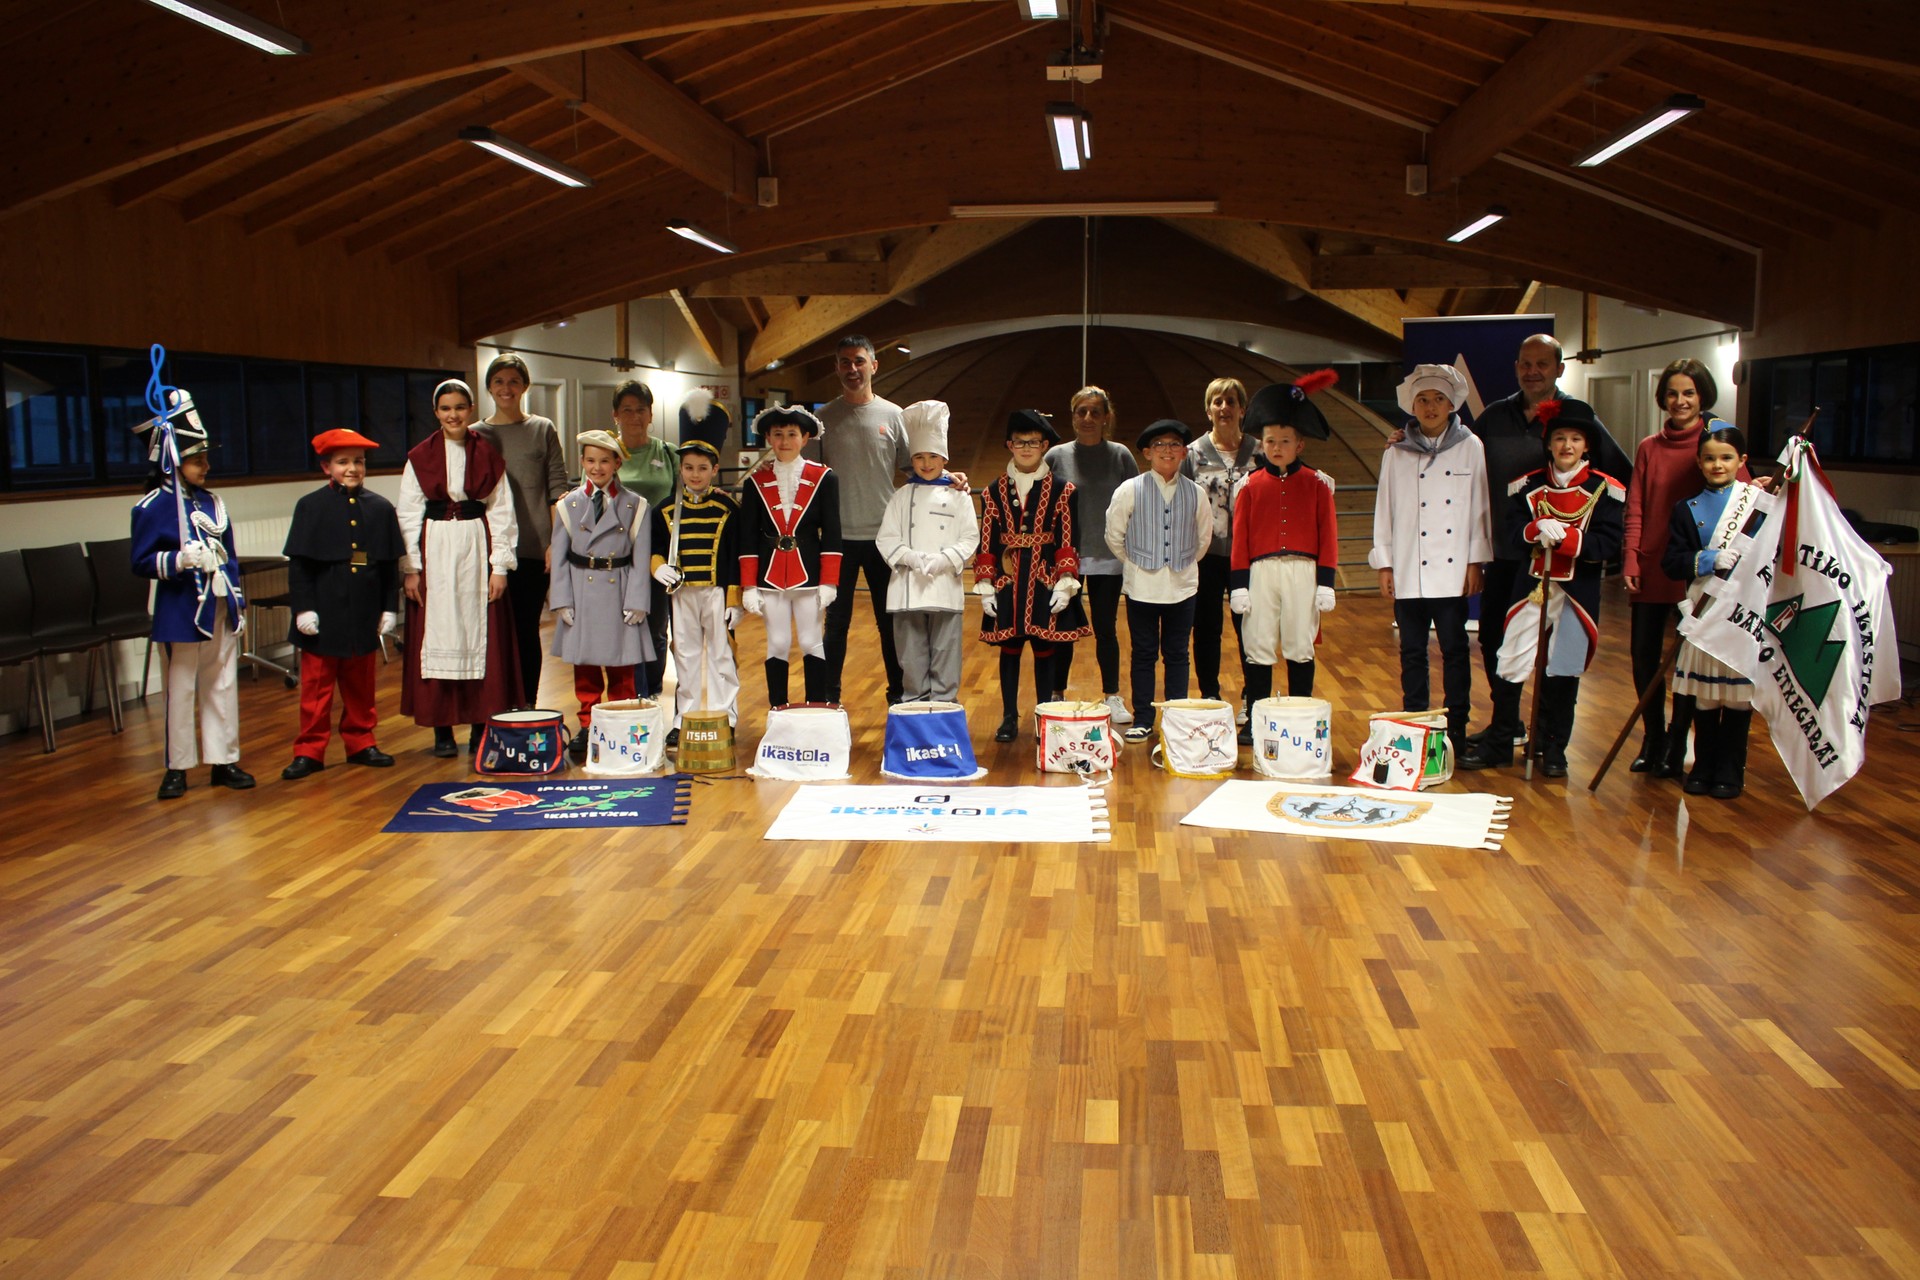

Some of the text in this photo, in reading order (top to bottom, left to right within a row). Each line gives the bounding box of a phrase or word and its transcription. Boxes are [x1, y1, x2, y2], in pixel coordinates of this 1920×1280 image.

[1717, 485, 1751, 550] KASTOLA
[686, 731, 717, 741] ITSASI
[762, 745, 830, 762] ikastola
[1048, 741, 1109, 765] IKASTOLA
